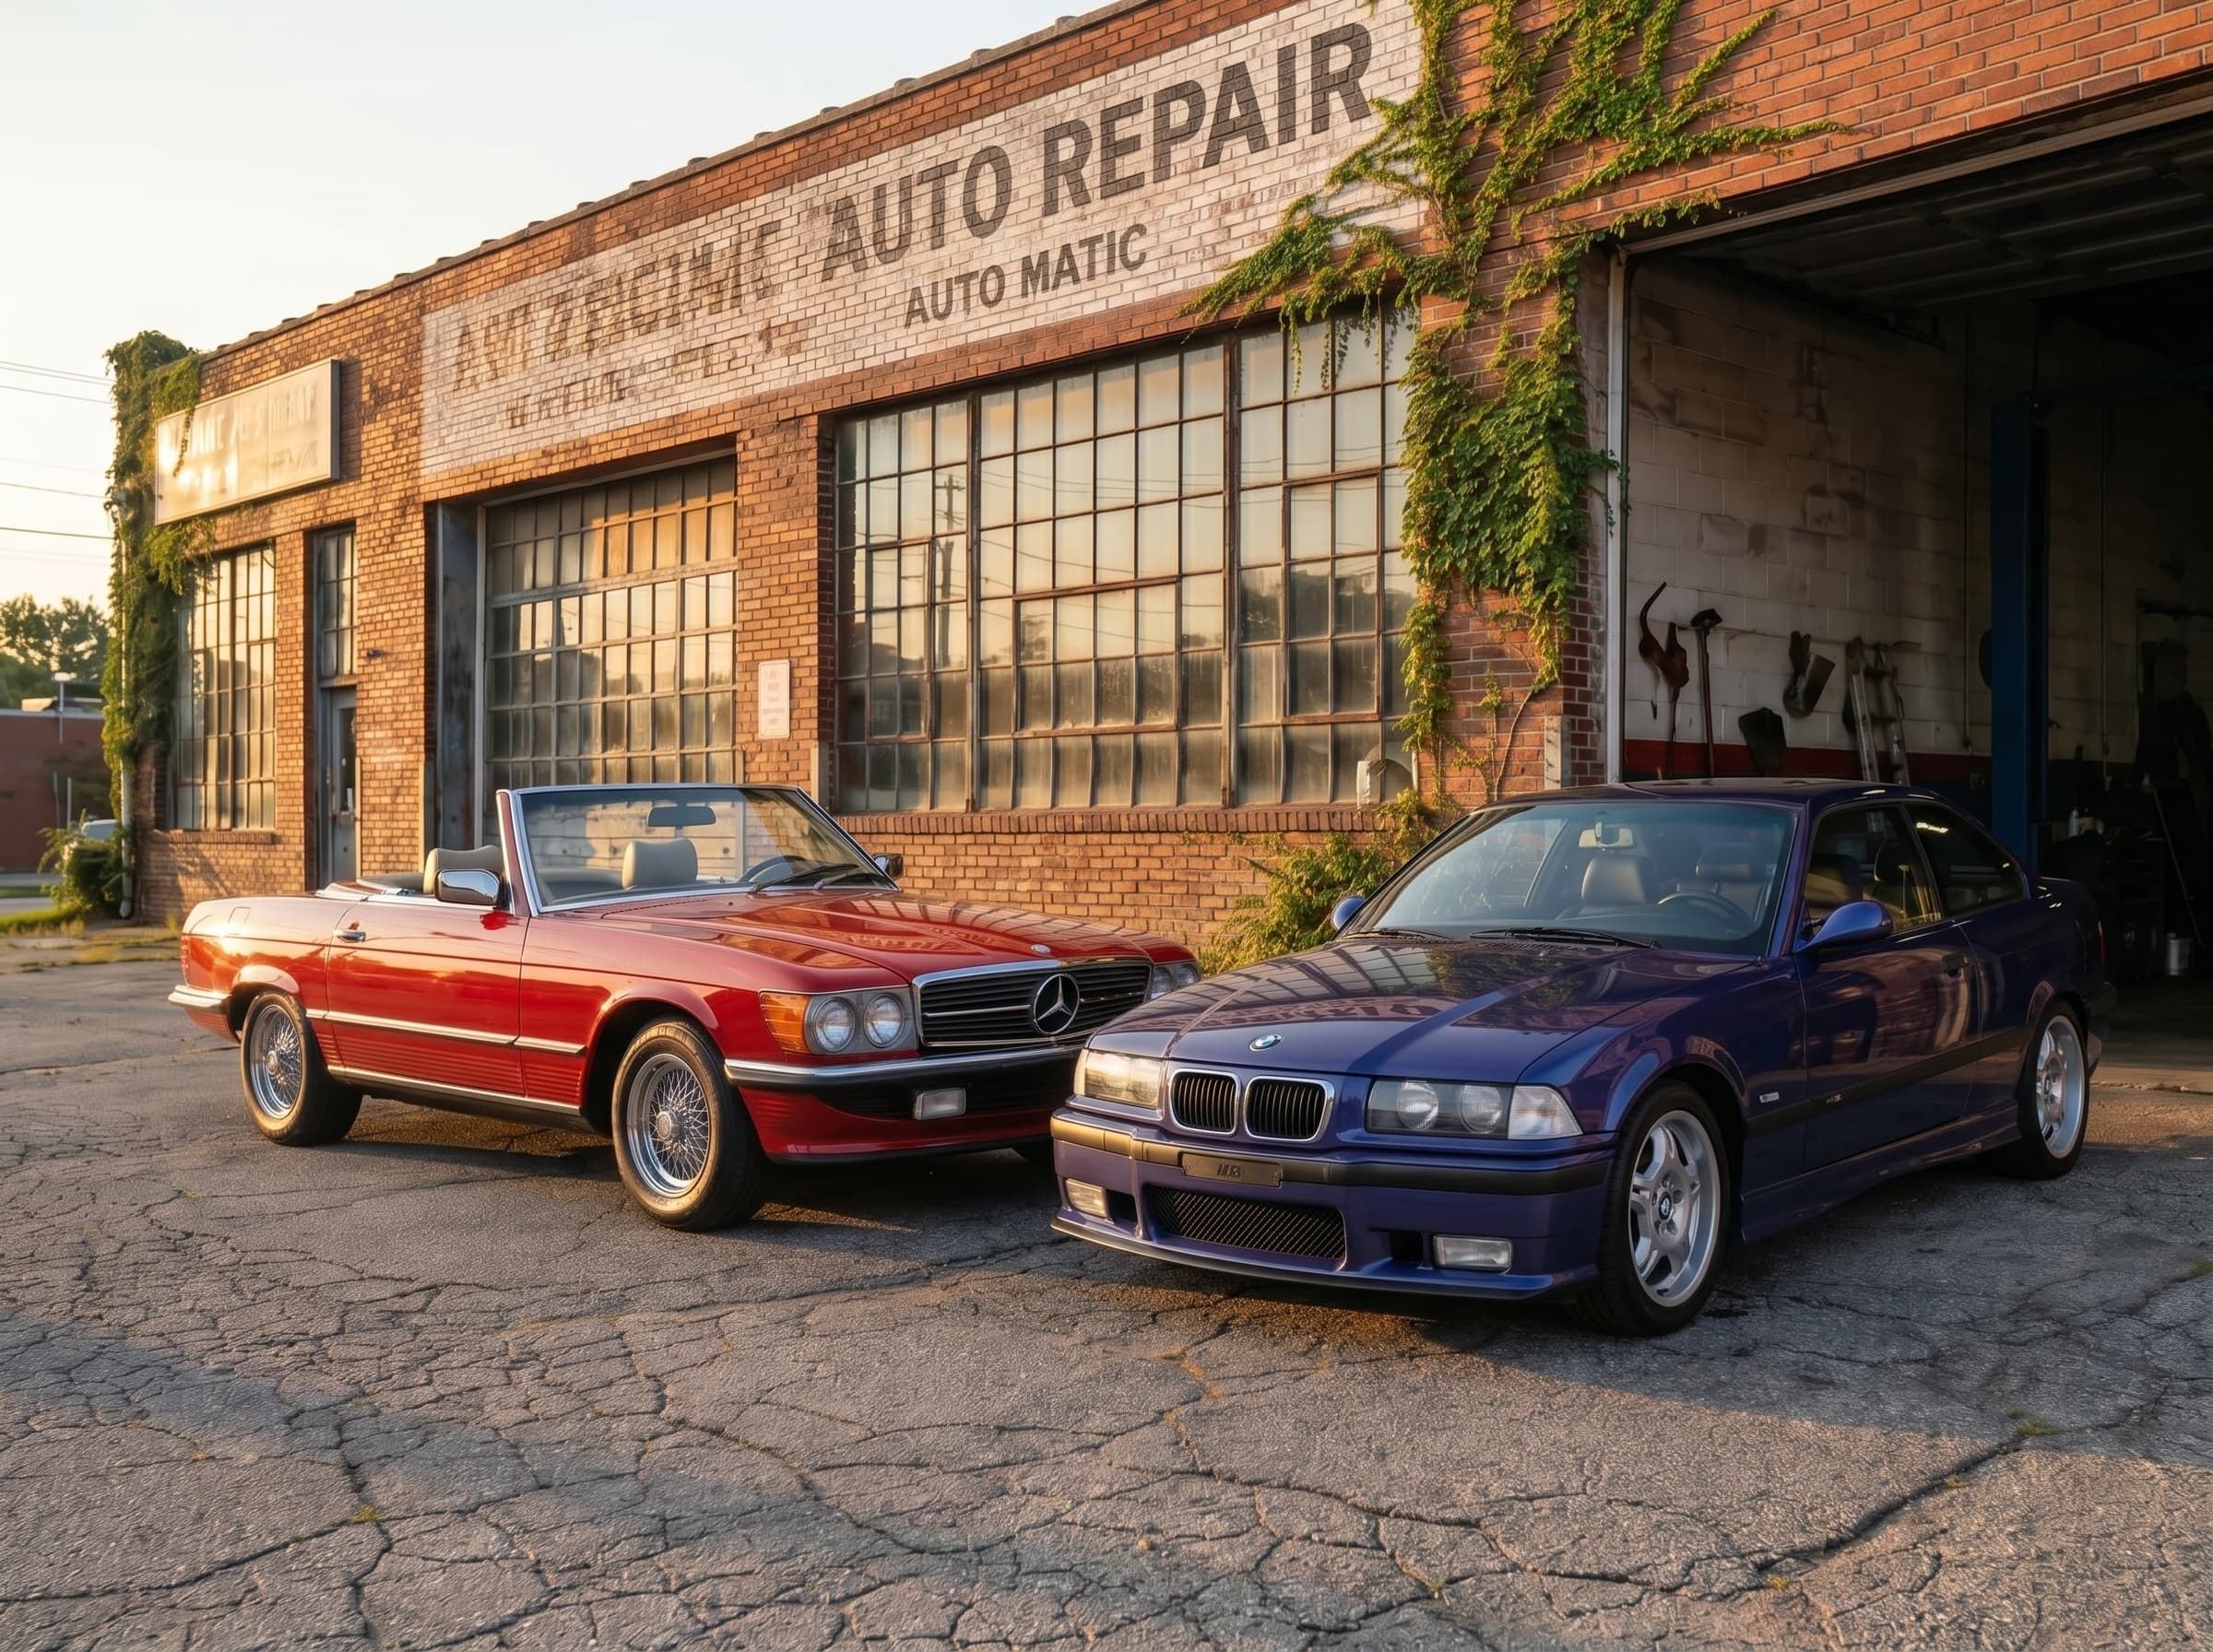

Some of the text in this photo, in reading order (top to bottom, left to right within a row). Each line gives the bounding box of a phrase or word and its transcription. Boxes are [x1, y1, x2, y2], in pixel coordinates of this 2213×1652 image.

[822, 21, 1373, 281] AUTO REPAIR
[903, 223, 1148, 329] AUTO MATIC
